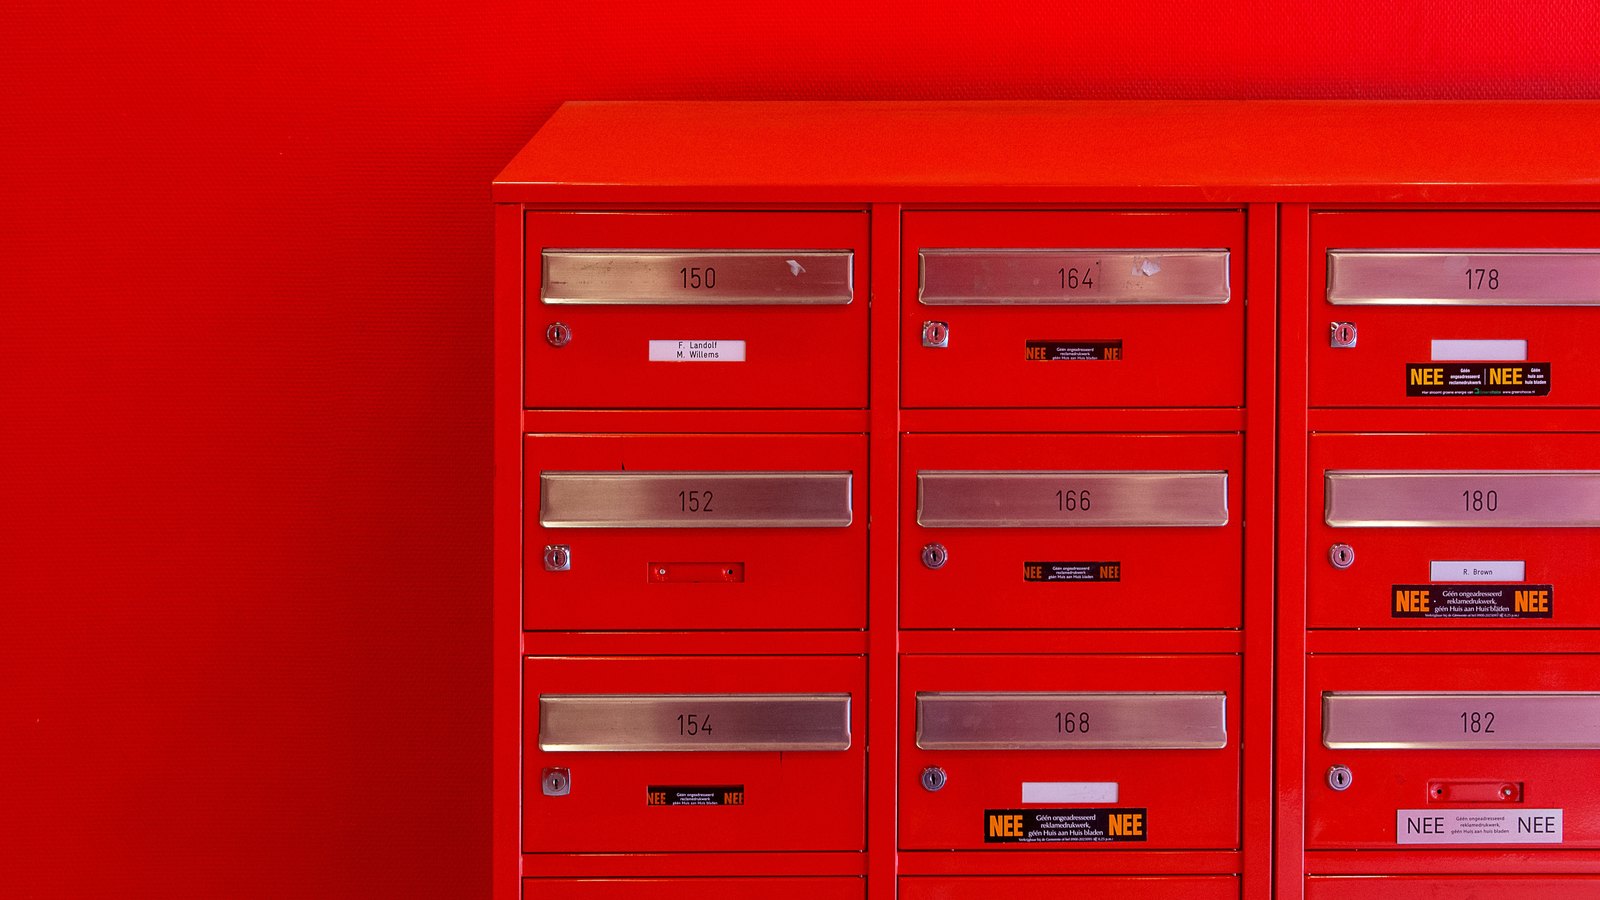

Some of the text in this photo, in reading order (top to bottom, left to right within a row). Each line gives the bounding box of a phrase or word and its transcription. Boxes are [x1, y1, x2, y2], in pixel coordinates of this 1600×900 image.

[680, 267, 716, 289] 150
[1058, 267, 1094, 289] 164
[1465, 268, 1499, 290] 178
[678, 341, 717, 349] F. Landolf
[1026, 347, 1046, 360] NEE
[1104, 348, 1121, 360] NE
[1411, 368, 1443, 385] NEE
[1490, 368, 1522, 385] NEE
[678, 490, 713, 512] 152
[1055, 489, 1091, 511] 166
[1462, 490, 1498, 512] 180
[1396, 591, 1429, 612] NEE
[1459, 590, 1502, 598] ongeadresseerd
[1515, 591, 1548, 612] NEE
[677, 714, 713, 736] 154
[1055, 711, 1090, 733] 168
[1460, 712, 1495, 733] 182
[990, 815, 1023, 836] NEE
[1053, 814, 1096, 822] ongeadresseerd
[1109, 814, 1142, 835] NEE
[1408, 817, 1444, 834] NEE
[1518, 817, 1555, 833] NEE
